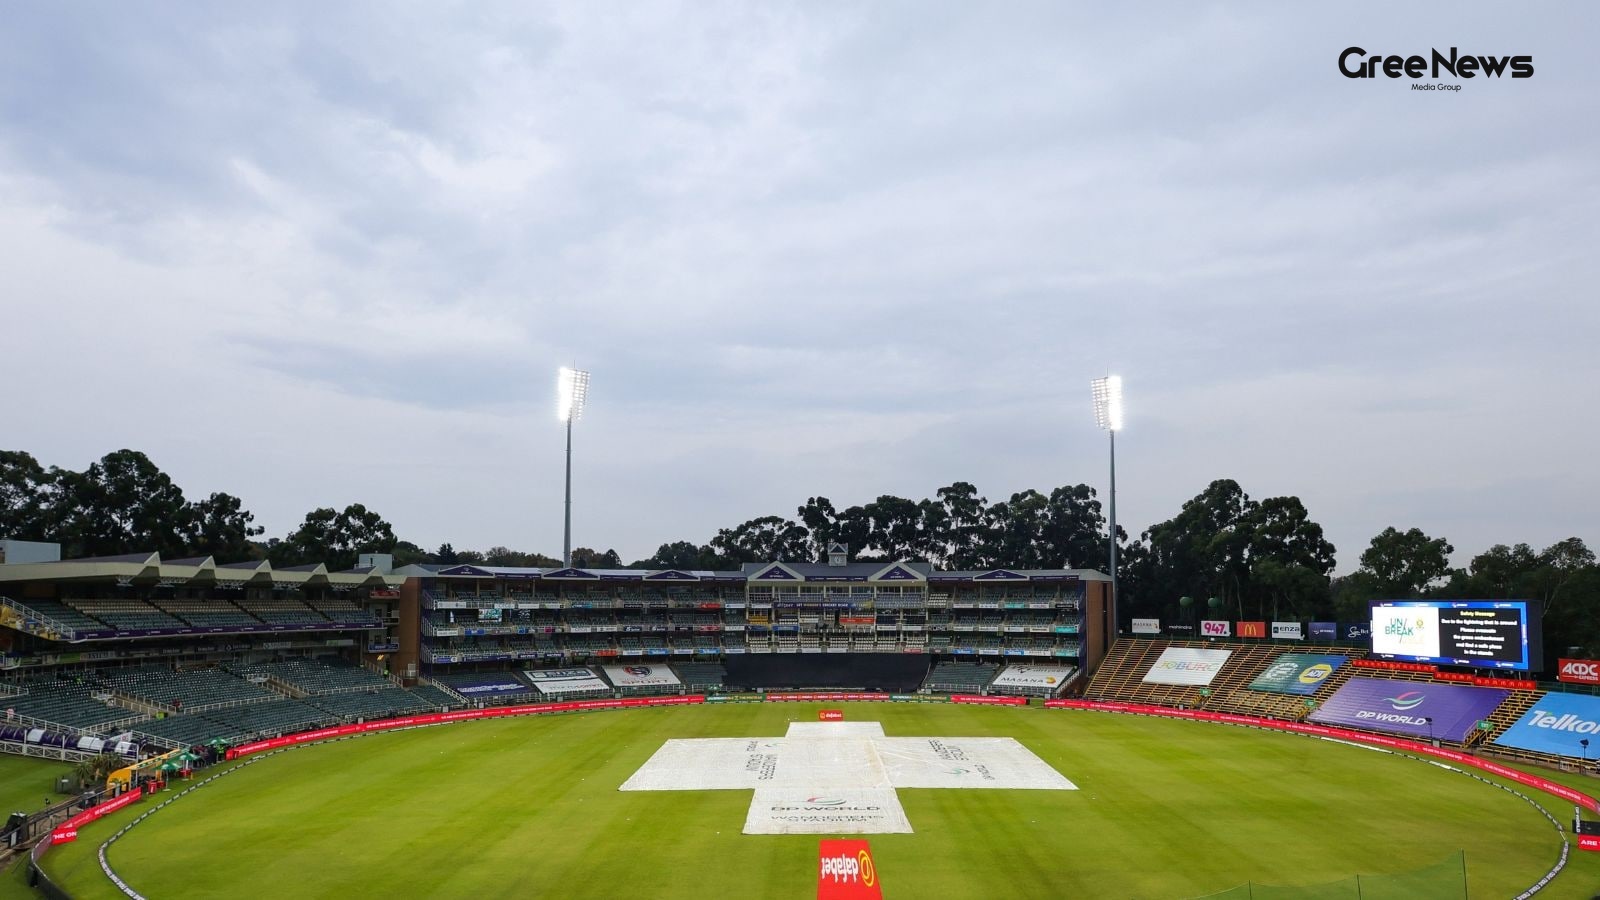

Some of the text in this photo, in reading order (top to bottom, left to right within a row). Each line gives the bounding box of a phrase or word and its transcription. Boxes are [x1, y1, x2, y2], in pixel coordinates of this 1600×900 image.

[1385, 626, 1414, 636] BREAK
[1305, 669, 1325, 678] ADT
[1562, 663, 1598, 676] ACDC
[1356, 711, 1427, 726] DP WORLD
[821, 853, 859, 883] dafabet
